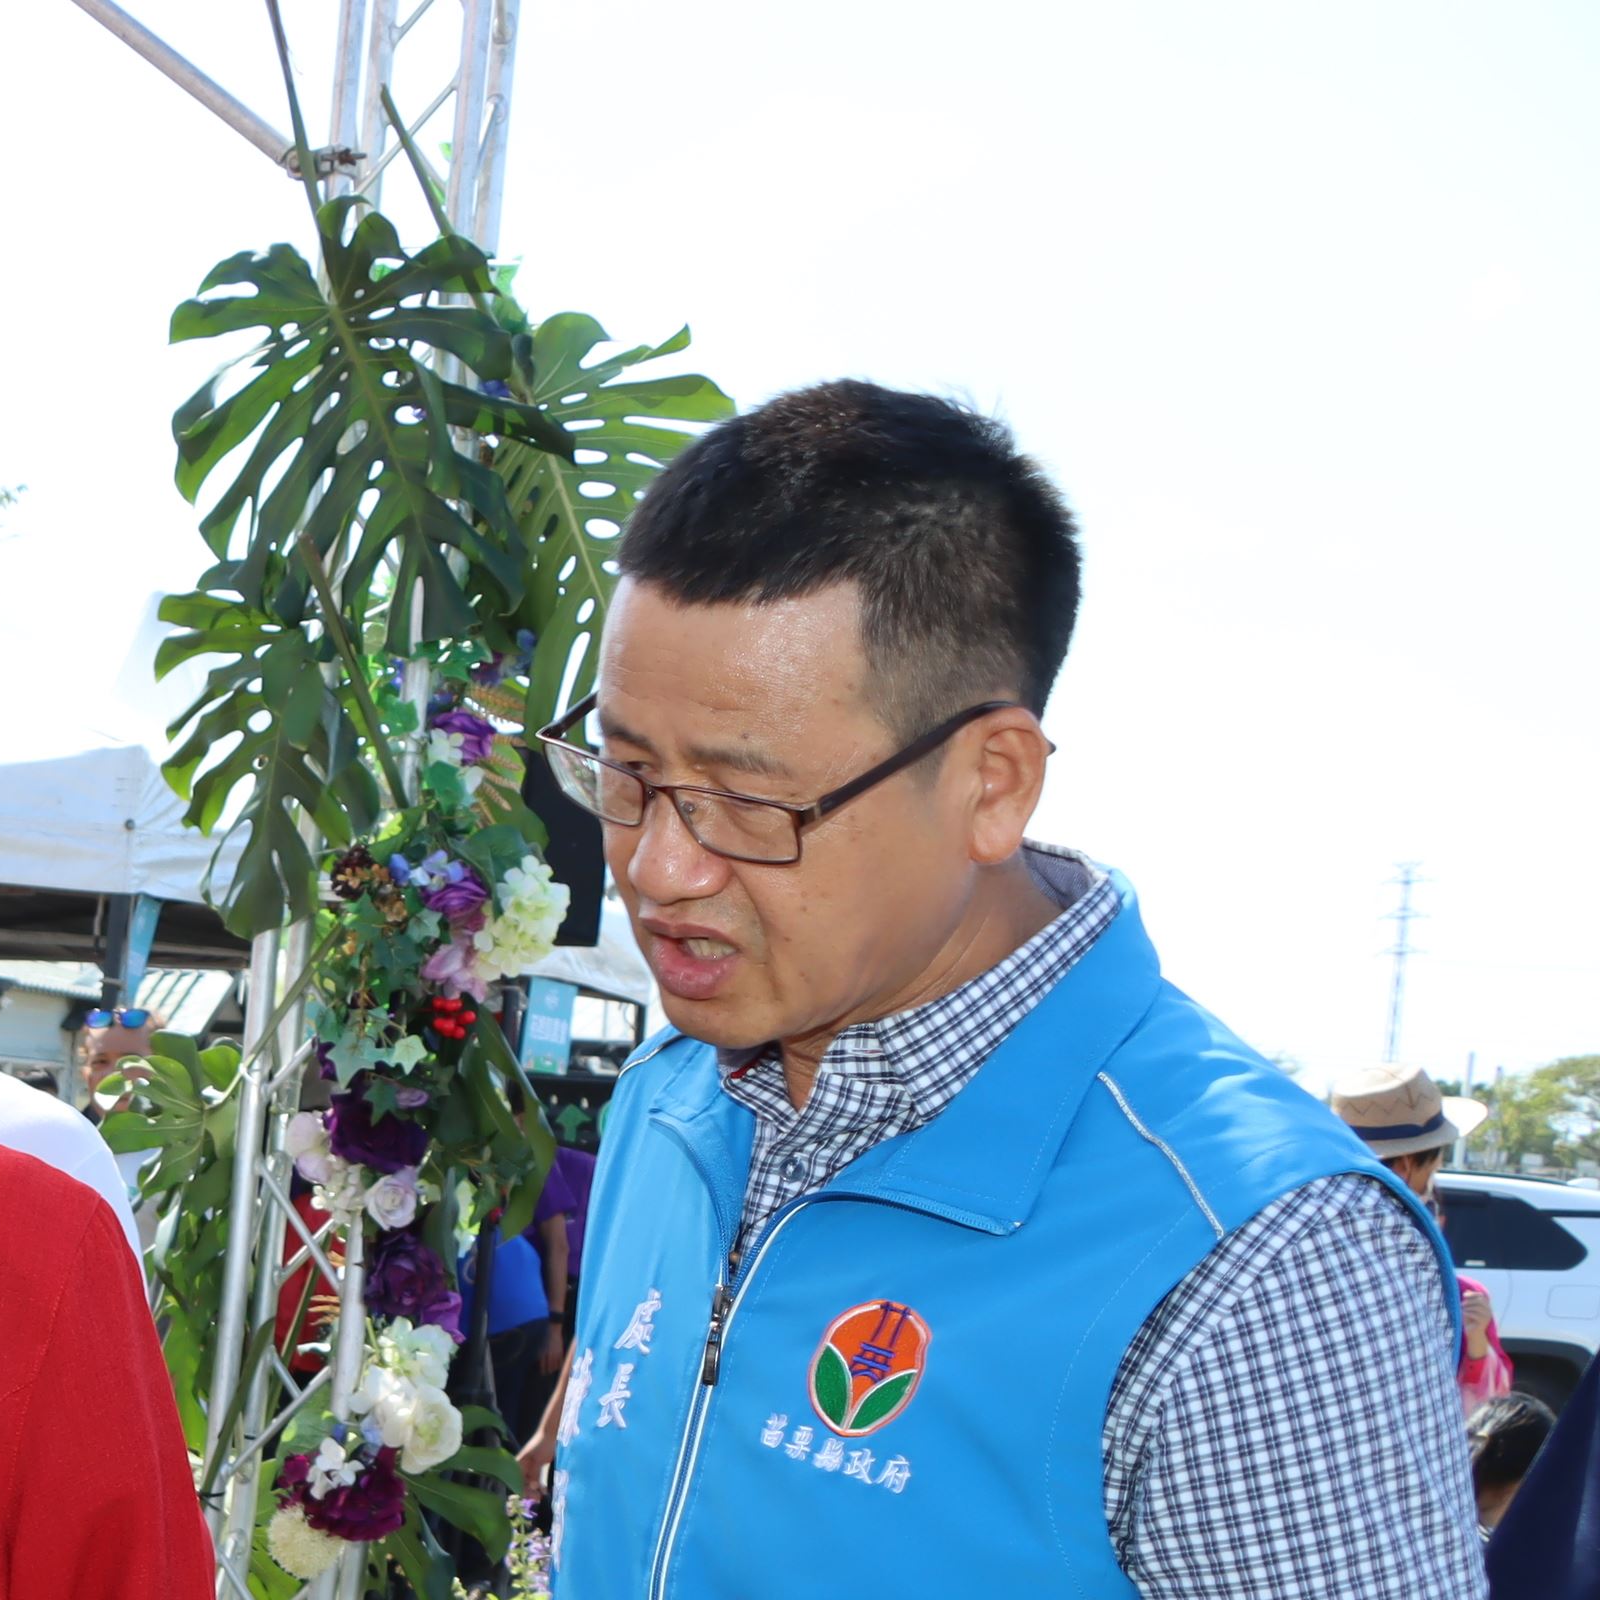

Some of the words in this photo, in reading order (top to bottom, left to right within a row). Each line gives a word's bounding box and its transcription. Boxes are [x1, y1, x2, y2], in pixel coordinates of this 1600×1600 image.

[760, 1412, 912, 1494] 苗栗縣政府
